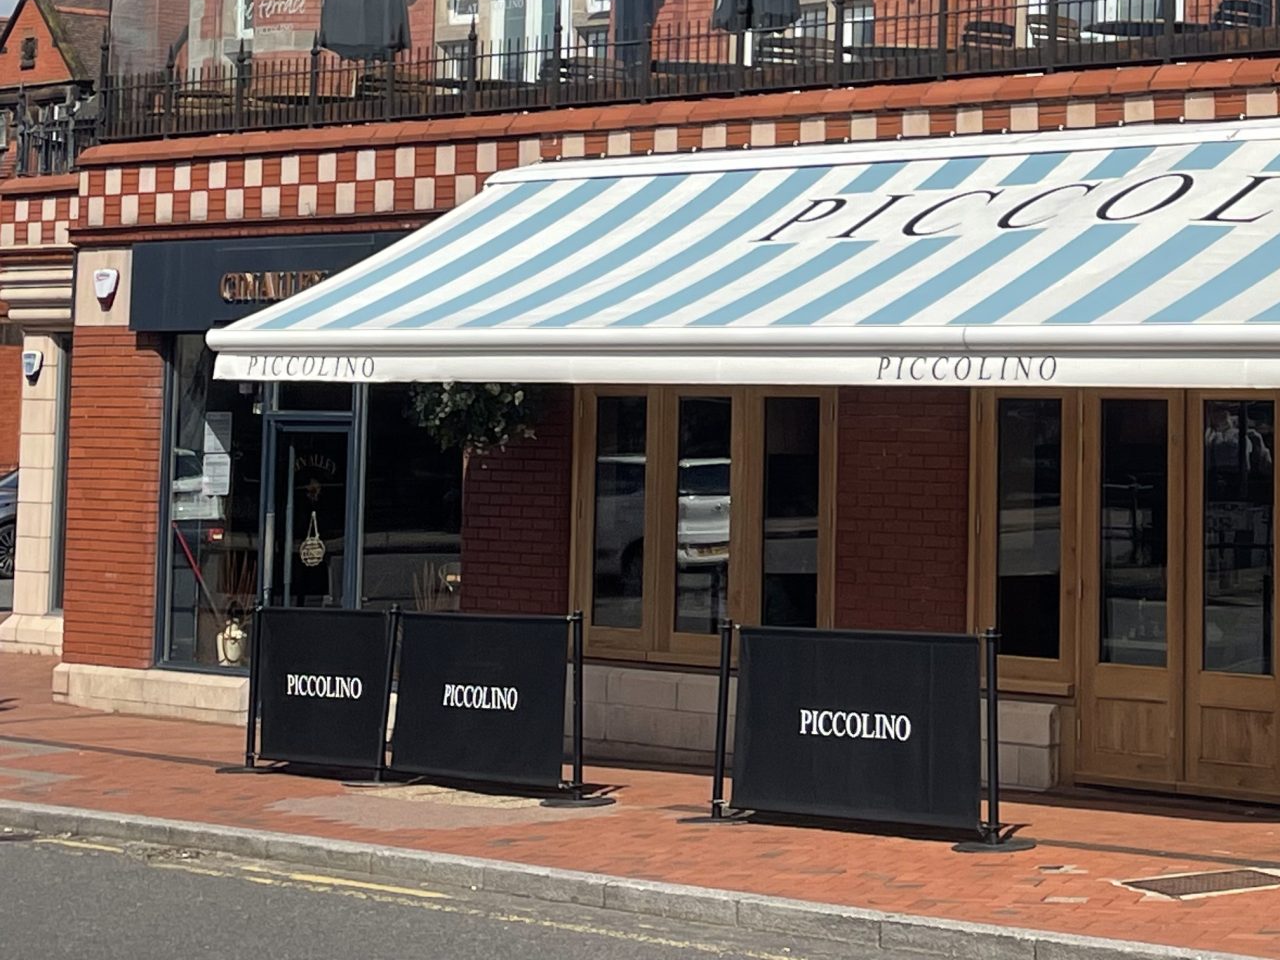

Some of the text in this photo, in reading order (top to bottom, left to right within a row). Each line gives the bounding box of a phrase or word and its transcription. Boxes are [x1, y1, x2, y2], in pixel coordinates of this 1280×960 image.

[247, 355, 375, 378] PICCOLINO
[876, 356, 1057, 381] PICCOLINO
[287, 674, 363, 699] PICCOLINO
[443, 684, 518, 711] PICCOLINO
[799, 709, 911, 741] PICCOLINO
